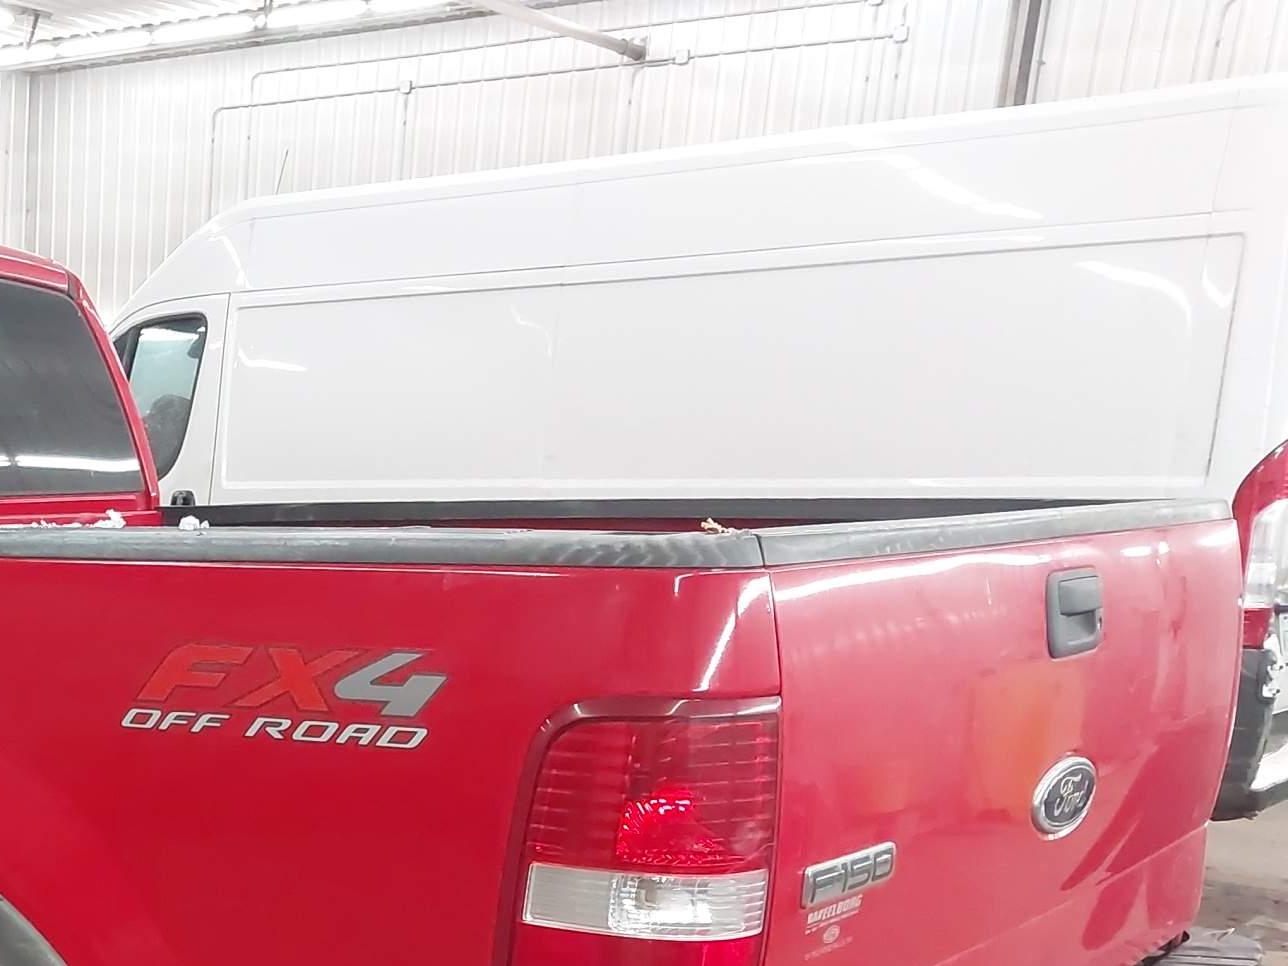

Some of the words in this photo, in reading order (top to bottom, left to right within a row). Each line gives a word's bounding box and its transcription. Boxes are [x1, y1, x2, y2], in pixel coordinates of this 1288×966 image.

[135, 643, 448, 717] FX4
[121, 707, 231, 733] OFF
[244, 716, 429, 749] ROAD
[1053, 772, 1090, 817] Ford
